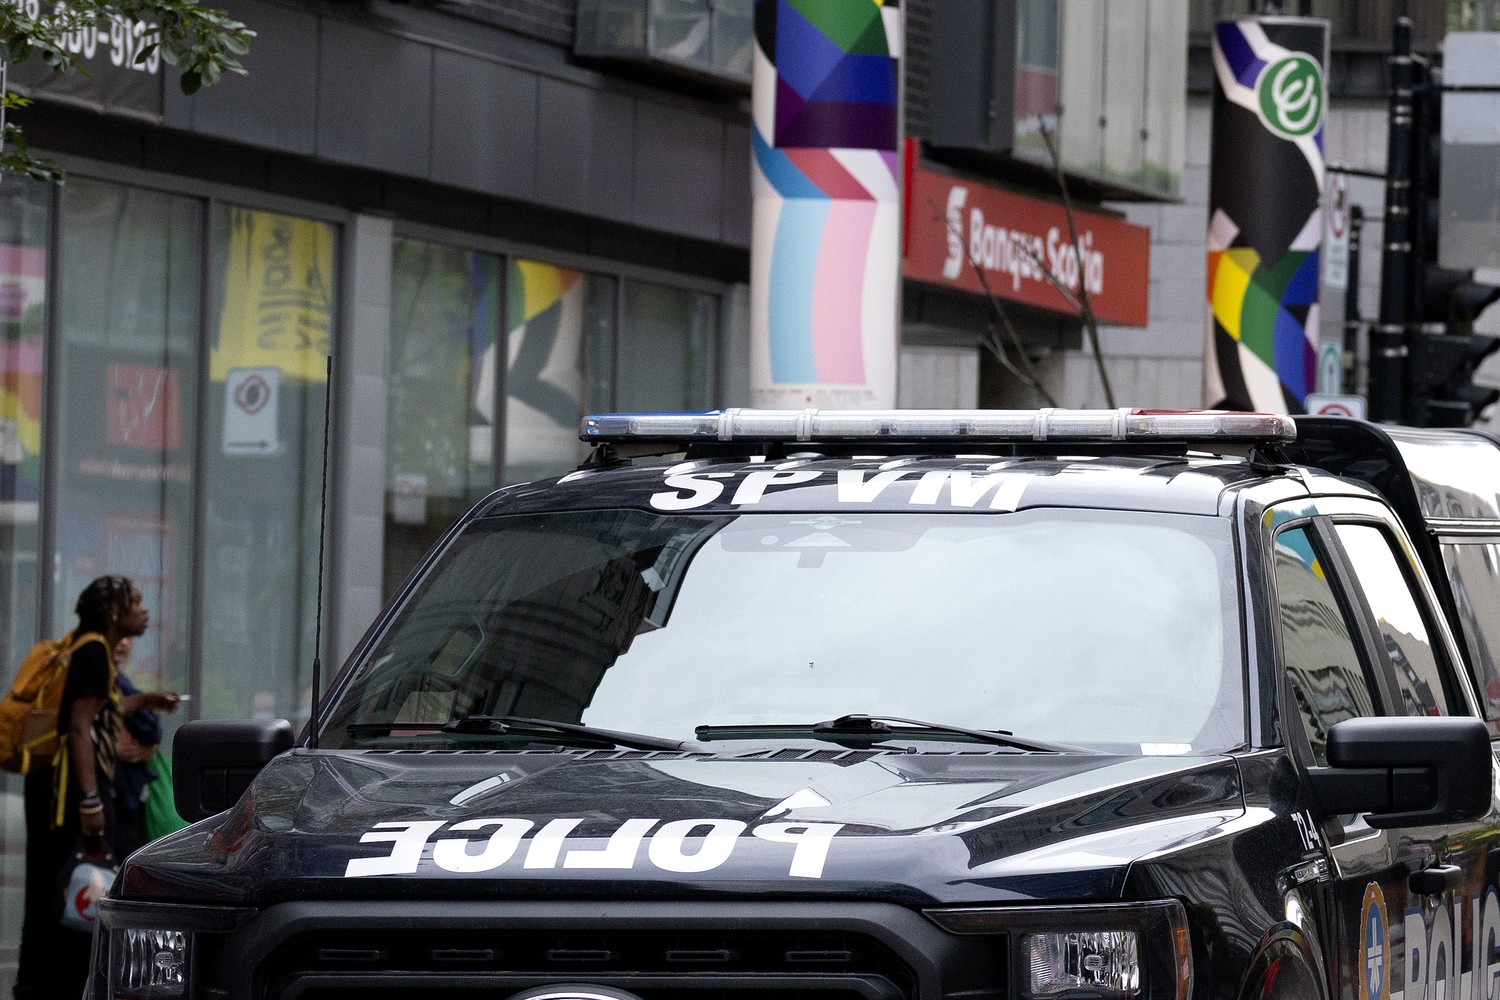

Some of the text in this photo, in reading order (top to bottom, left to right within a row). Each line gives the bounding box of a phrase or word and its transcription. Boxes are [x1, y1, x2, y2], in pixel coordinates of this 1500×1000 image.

[968, 207, 1104, 295] Banque Scotia
[649, 468, 1035, 512] SPVM
[1290, 809, 1322, 851] 72-4
